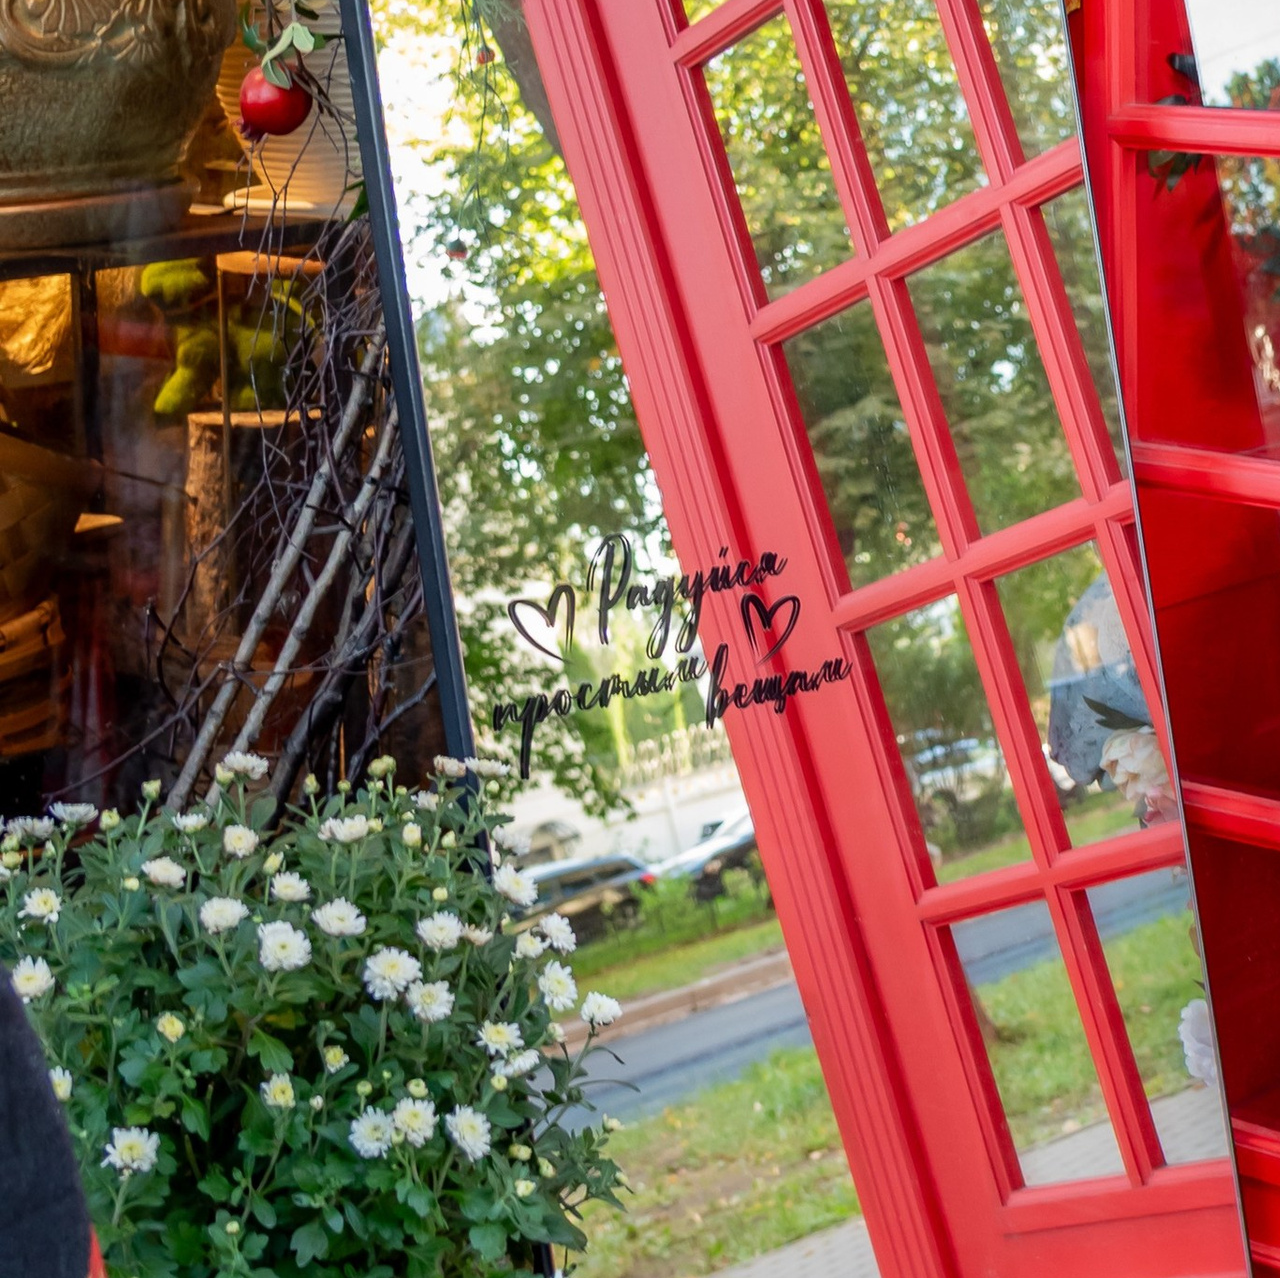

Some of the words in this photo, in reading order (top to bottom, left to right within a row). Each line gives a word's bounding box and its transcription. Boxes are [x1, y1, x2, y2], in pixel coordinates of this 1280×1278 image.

[587, 533, 788, 660] Радуйся
[493, 656, 709, 780] простым
[706, 642, 853, 730] вещам
